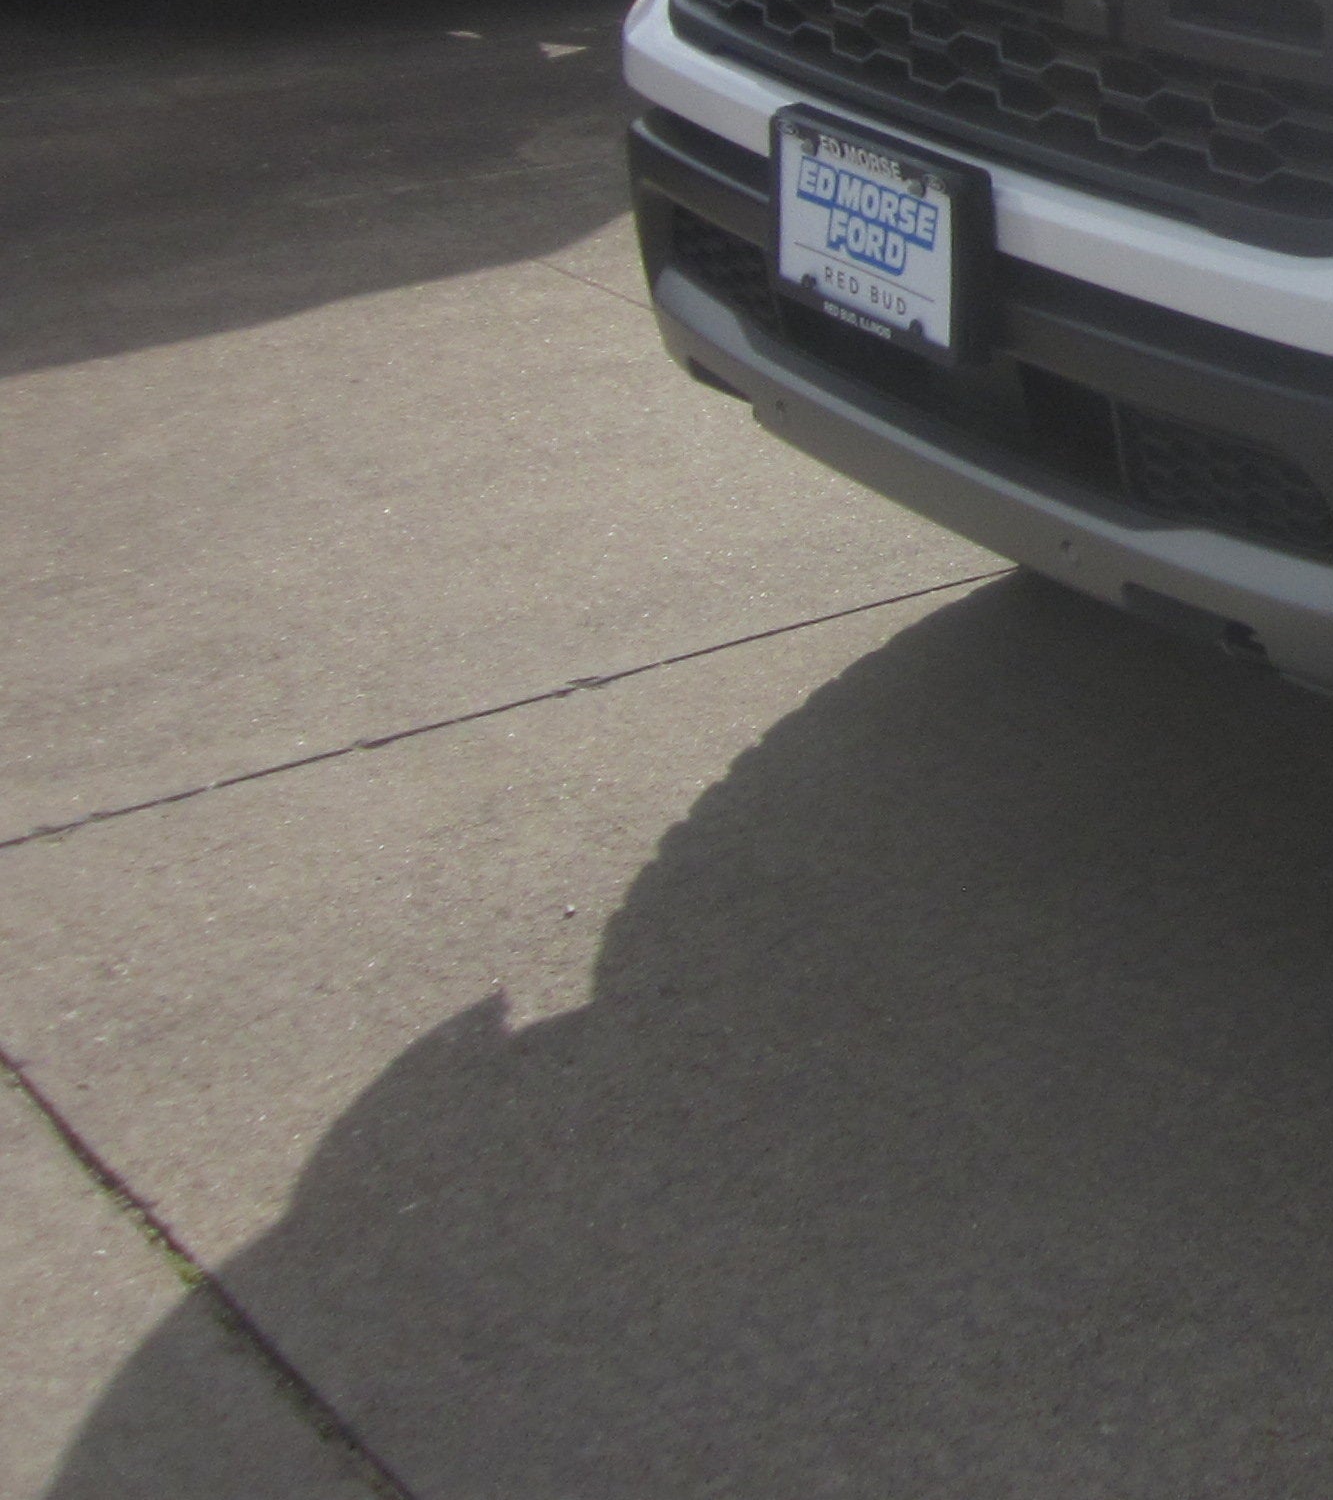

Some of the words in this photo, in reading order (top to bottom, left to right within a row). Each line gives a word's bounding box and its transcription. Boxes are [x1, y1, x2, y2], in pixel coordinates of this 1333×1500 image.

[819, 134, 842, 160] ED
[843, 143, 902, 180] MORSE
[798, 156, 838, 206] ED
[837, 170, 938, 248] MORSE
[826, 209, 906, 275] FORD
[824, 265, 860, 296] RED
[870, 285, 907, 316] BUD
